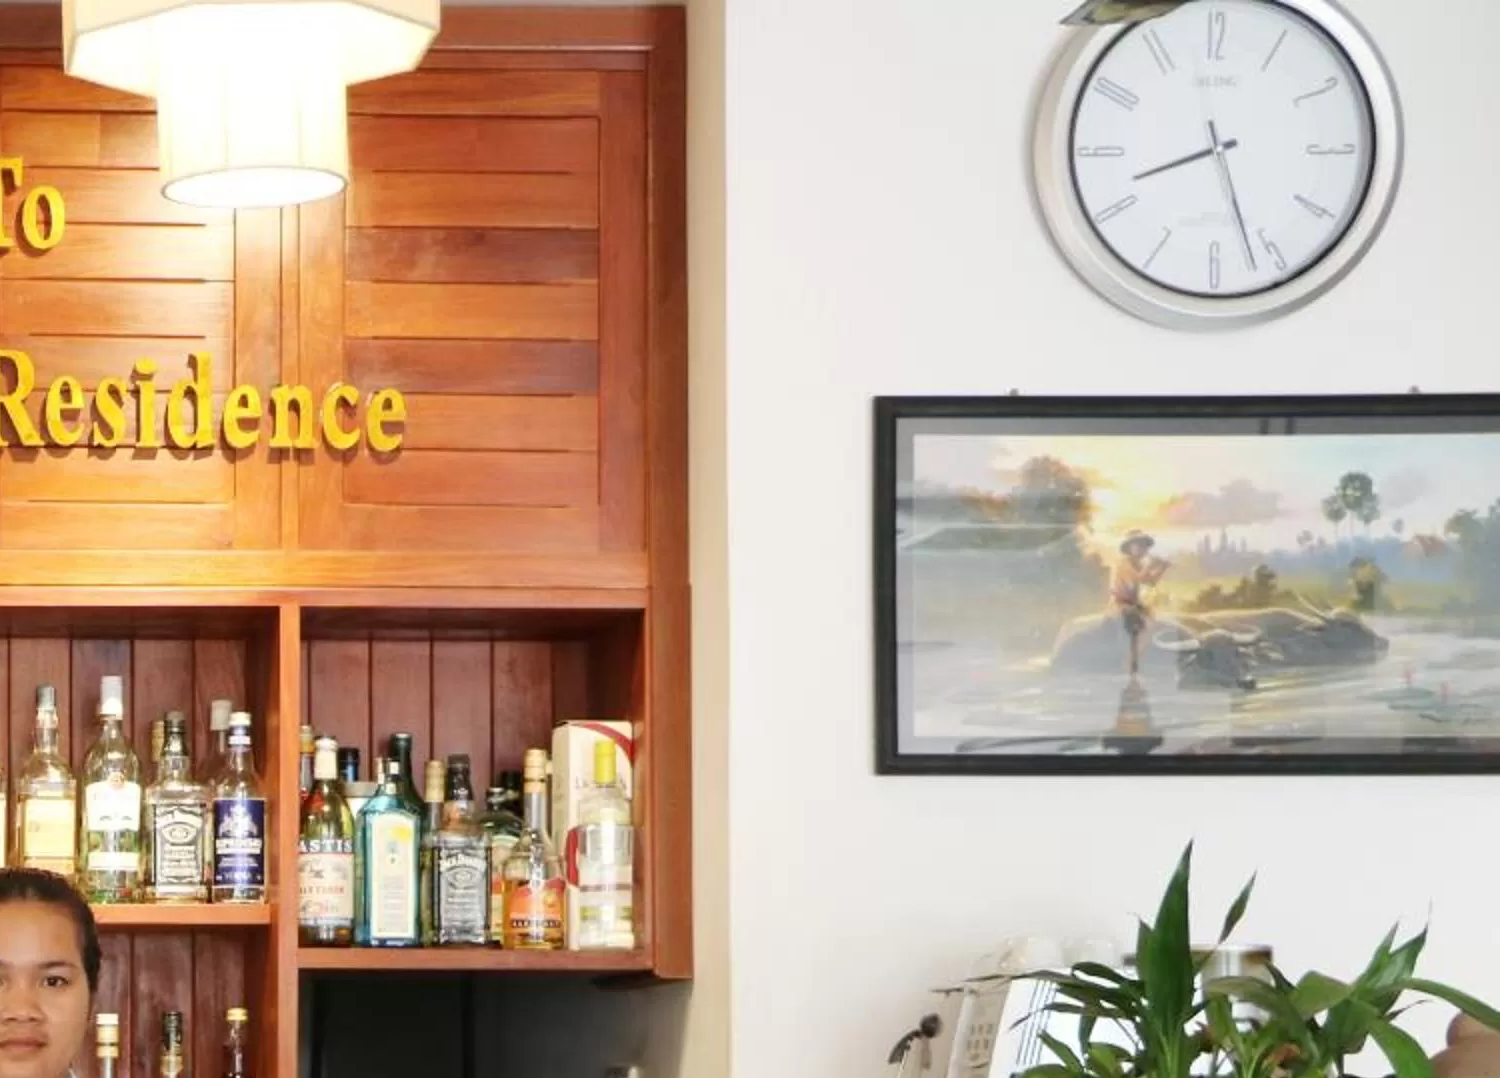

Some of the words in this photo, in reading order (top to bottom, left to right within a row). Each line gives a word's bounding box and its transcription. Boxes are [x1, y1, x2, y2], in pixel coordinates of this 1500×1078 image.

[1207, 11, 1226, 61] 12
[1261, 29, 1288, 73] 1
[1293, 77, 1338, 108] 2
[1305, 143, 1356, 155] 3
[1293, 194, 1336, 219] 4
[1142, 226, 1172, 269] 7
[1208, 241, 1220, 289] 6
[1258, 228, 1288, 271] 5
[299, 839, 353, 853] ASTIS
